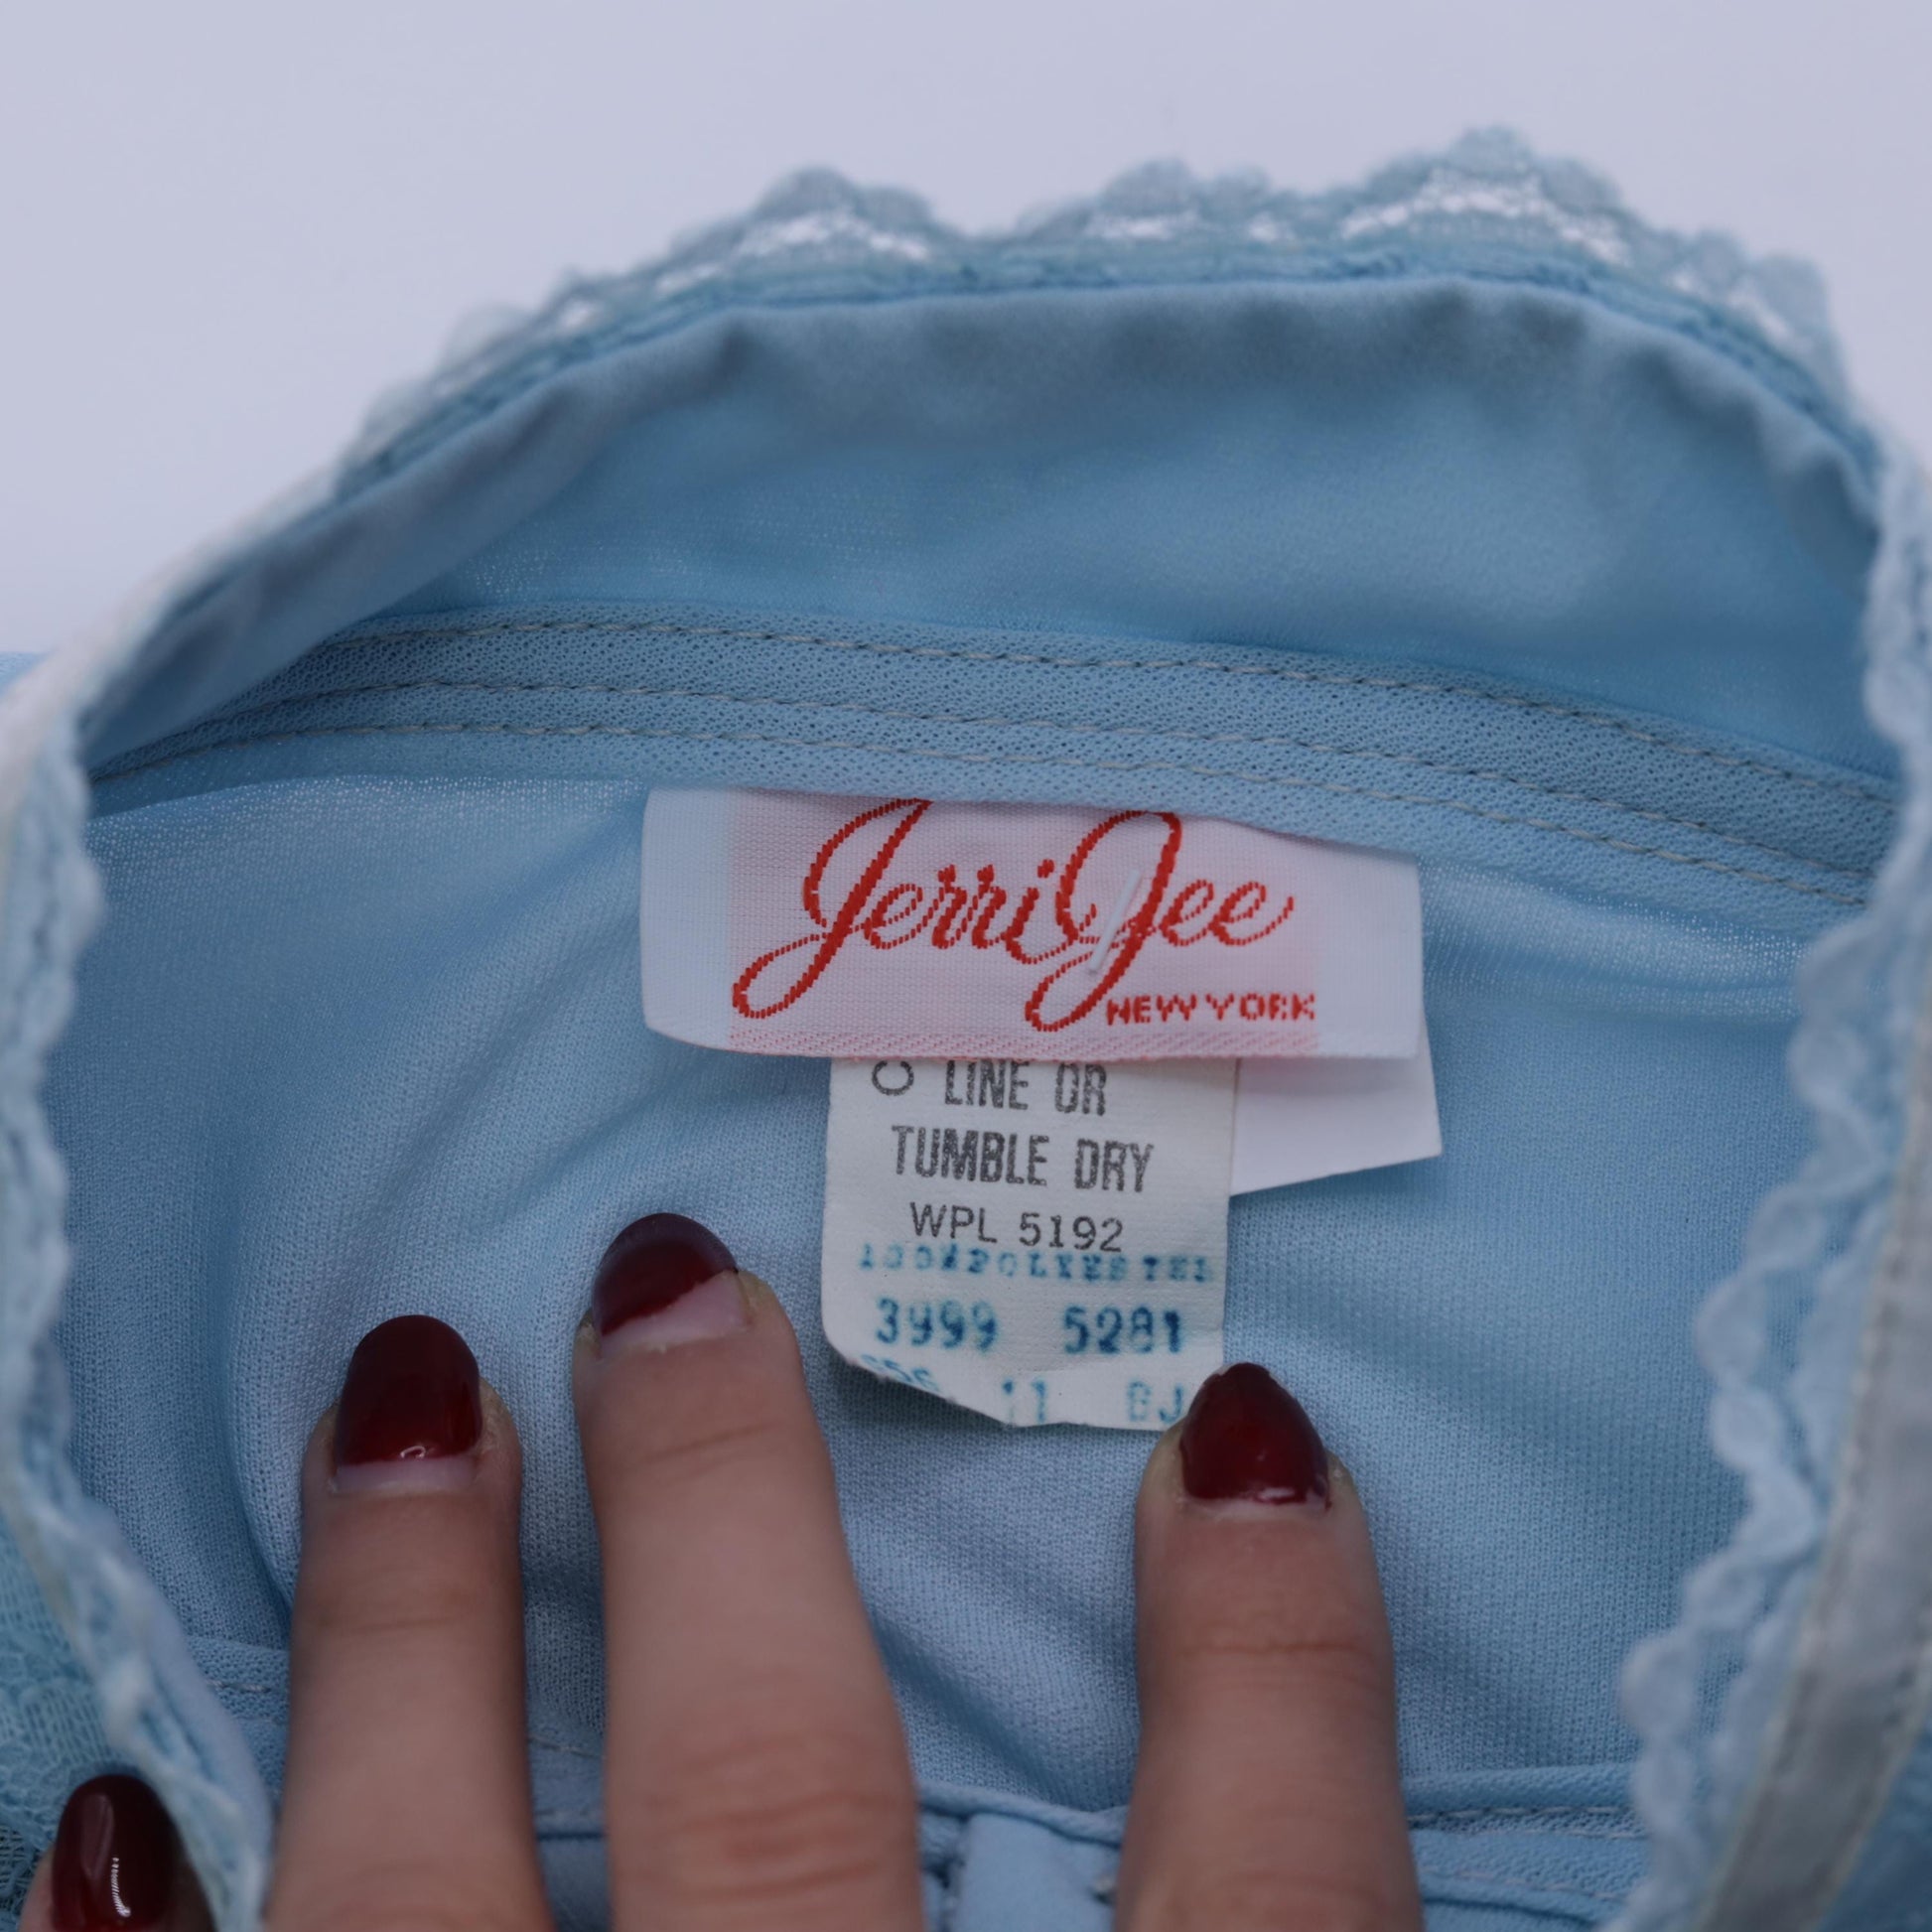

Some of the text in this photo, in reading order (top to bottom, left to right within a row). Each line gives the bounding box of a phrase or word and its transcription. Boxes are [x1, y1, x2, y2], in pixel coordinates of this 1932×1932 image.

[1204, 993, 1316, 1022] YORK
[944, 1059, 1107, 1116] LINE OR
[892, 1125, 1155, 1192] TUMBLE DRY
[909, 1201, 1124, 1253] WPL 5192
[876, 1298, 998, 1352] 3999
